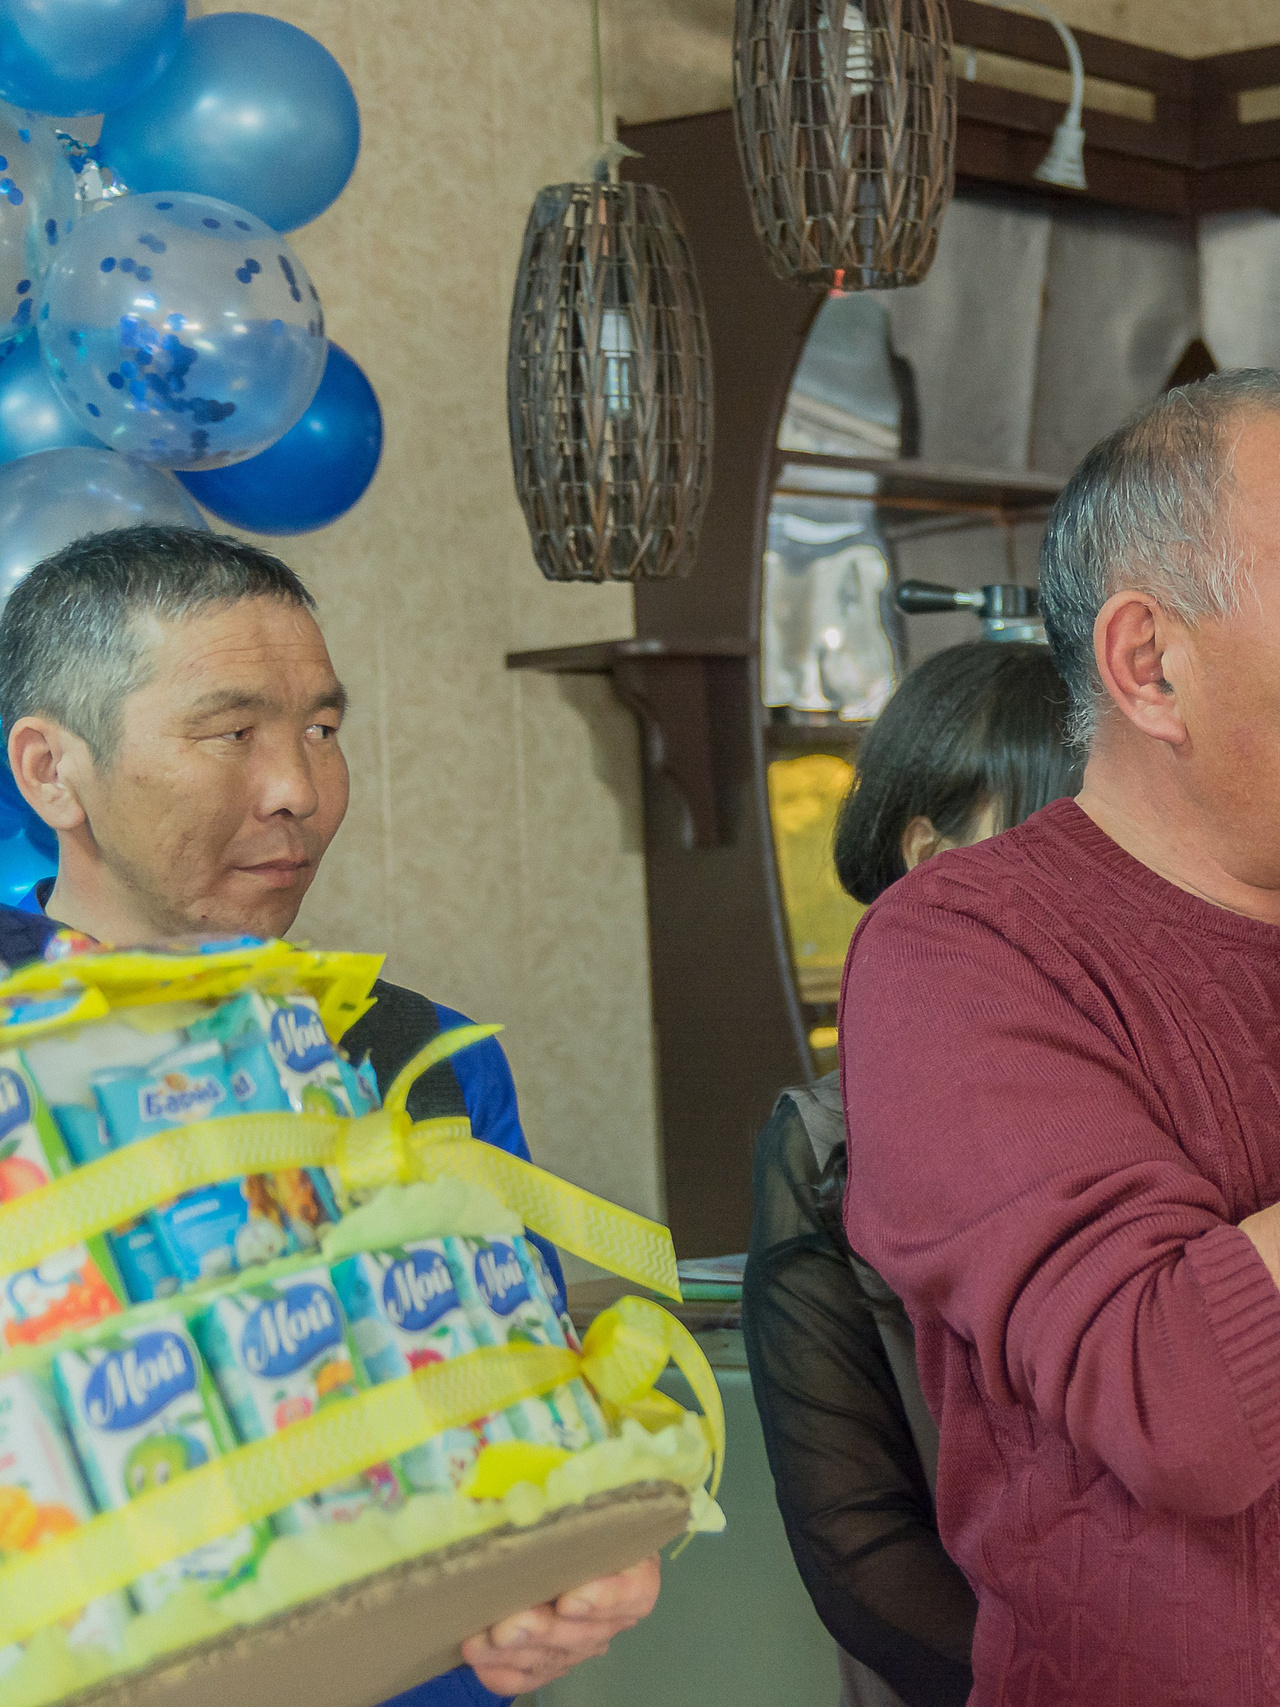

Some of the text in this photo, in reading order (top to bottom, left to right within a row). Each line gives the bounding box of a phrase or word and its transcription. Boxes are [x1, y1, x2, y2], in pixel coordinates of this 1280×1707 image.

[268, 1011, 328, 1067] Мой
[386, 1256, 454, 1324] Мой
[478, 1250, 525, 1306] Мой
[247, 1290, 335, 1371] Мой
[88, 1338, 187, 1426] Мой
